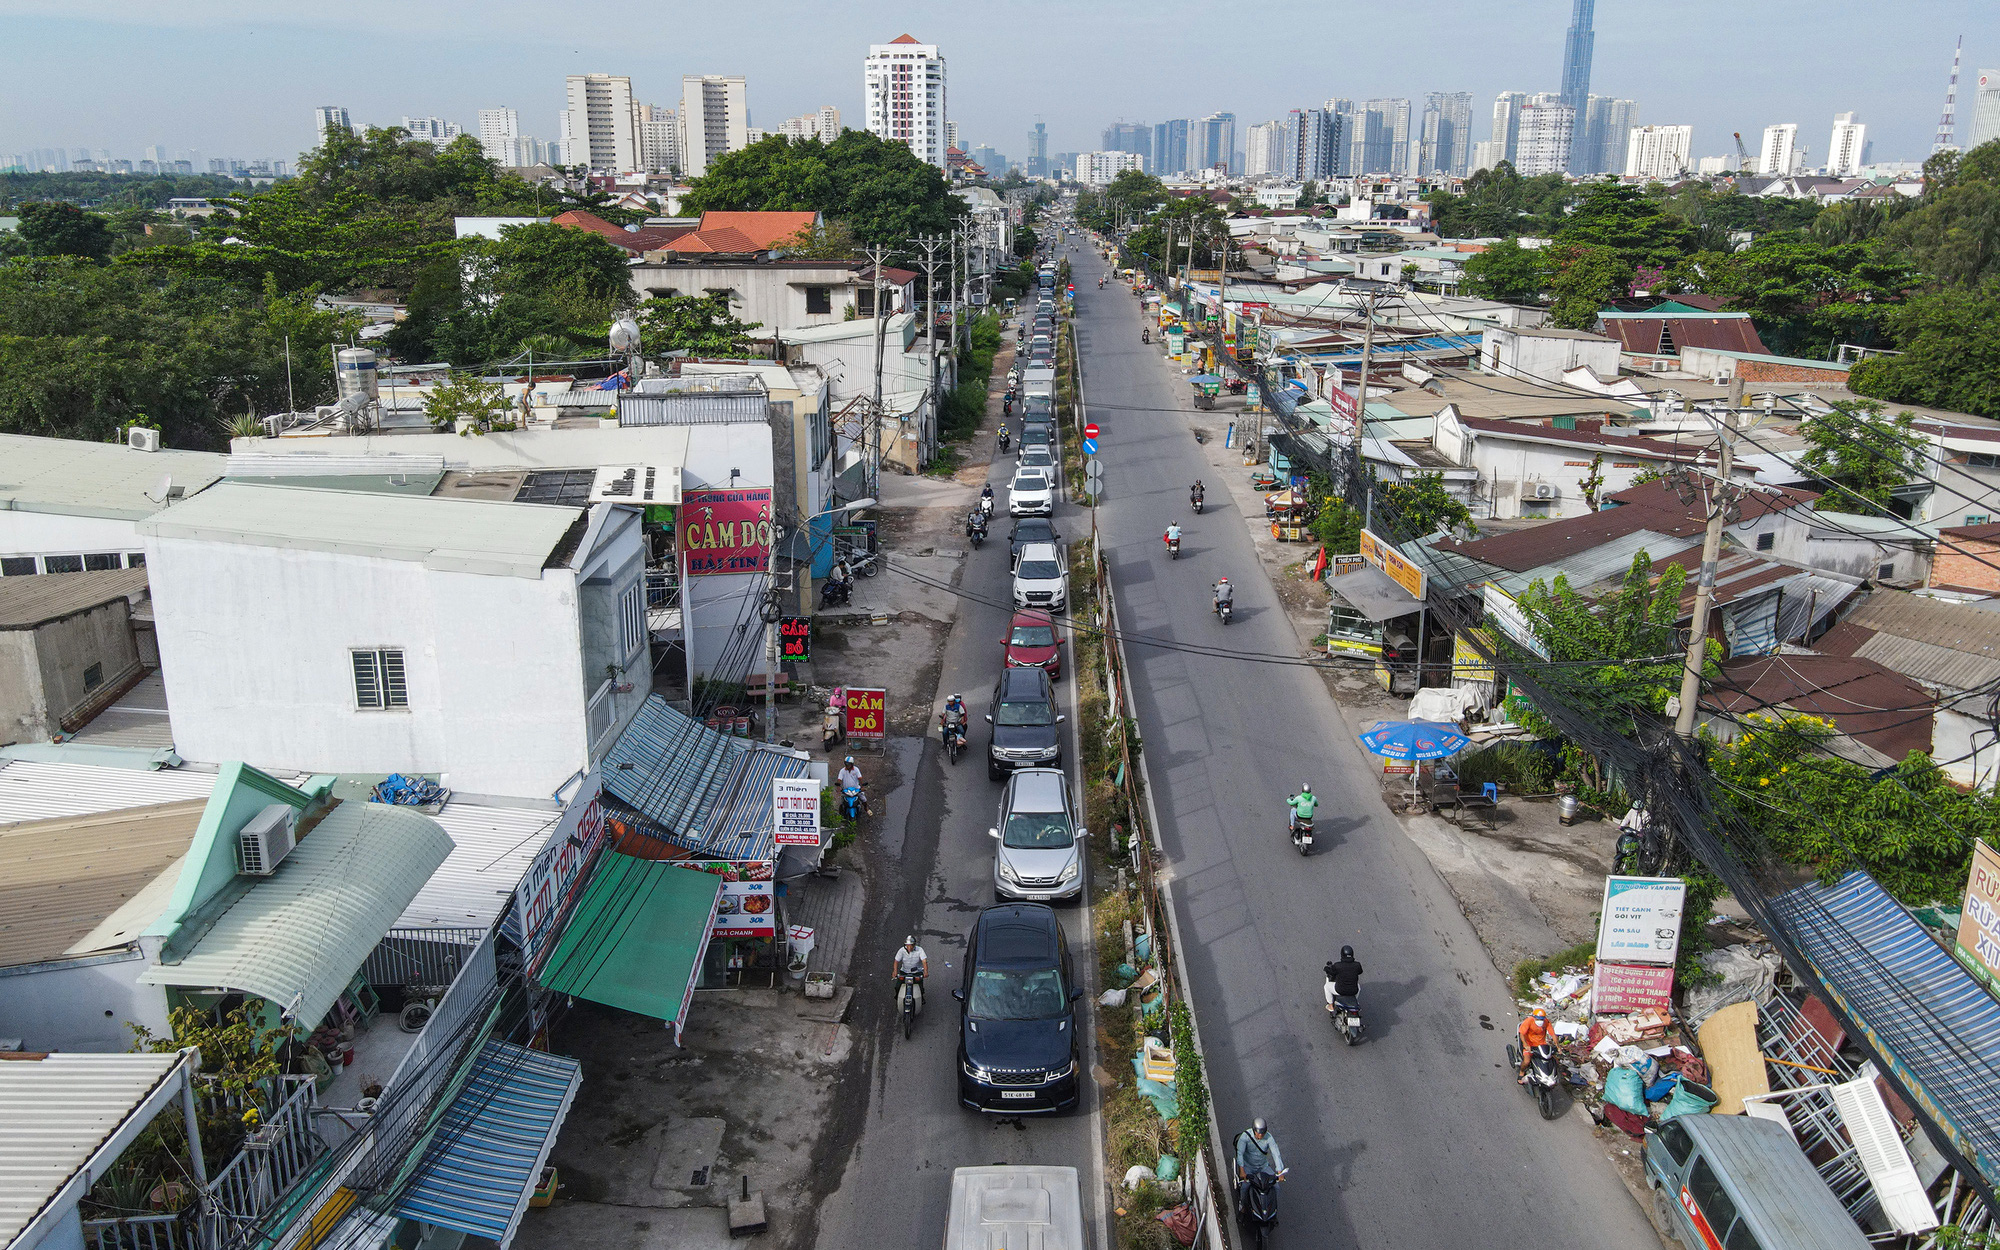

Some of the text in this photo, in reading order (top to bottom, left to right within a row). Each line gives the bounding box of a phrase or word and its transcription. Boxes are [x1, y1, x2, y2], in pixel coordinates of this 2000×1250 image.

[727, 492, 744, 501] CỬA
[746, 492, 769, 501] HÀNG
[687, 504, 769, 549] CẦM ĐỒ
[786, 638, 803, 655] ĐỒ
[848, 692, 883, 710] CẦM
[854, 712, 877, 729] ĐỒ
[524, 882, 531, 907] 3
[1977, 932, 2000, 967] XỊT
[1645, 969, 1655, 977] TÀI
[1656, 969, 1666, 977] XẾ
[1607, 985, 1625, 993] NHẬP
[1626, 985, 1645, 995] HÀNG
[1646, 988, 1668, 997] THÁNG
[1605, 995, 1623, 1003] TRIỆU
[1637, 997, 1657, 1005] TRIỆU
